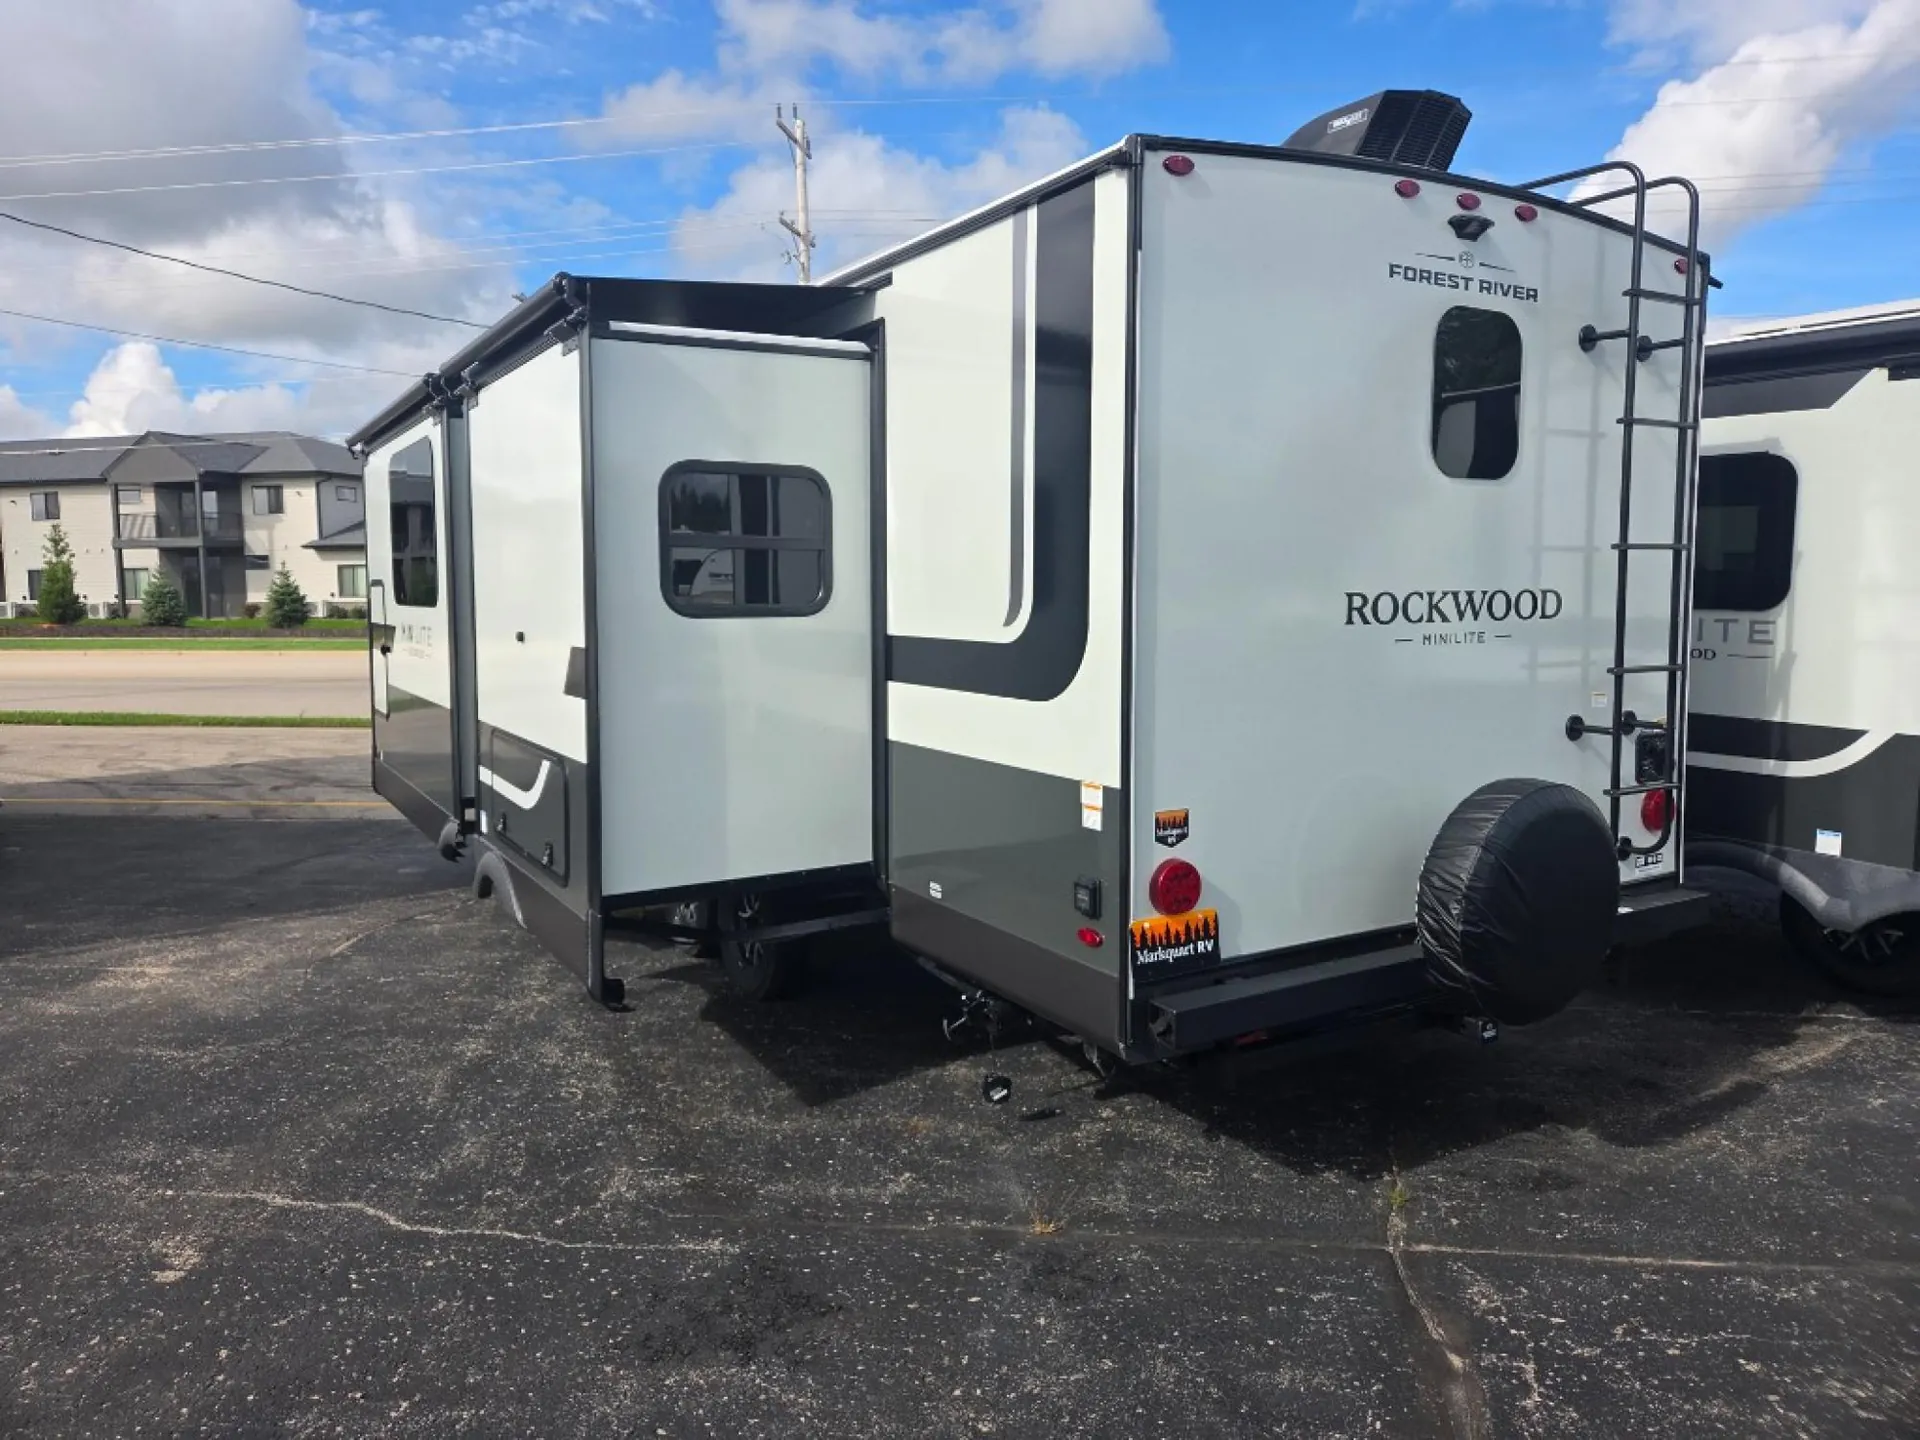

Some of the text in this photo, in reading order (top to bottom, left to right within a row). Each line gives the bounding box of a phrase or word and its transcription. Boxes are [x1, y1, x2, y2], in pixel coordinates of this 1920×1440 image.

[1388, 263, 1539, 303] FOREST RIVER
[1344, 589, 1563, 625] ROCKWOOD
[1135, 938, 1214, 964] Markquart RV
